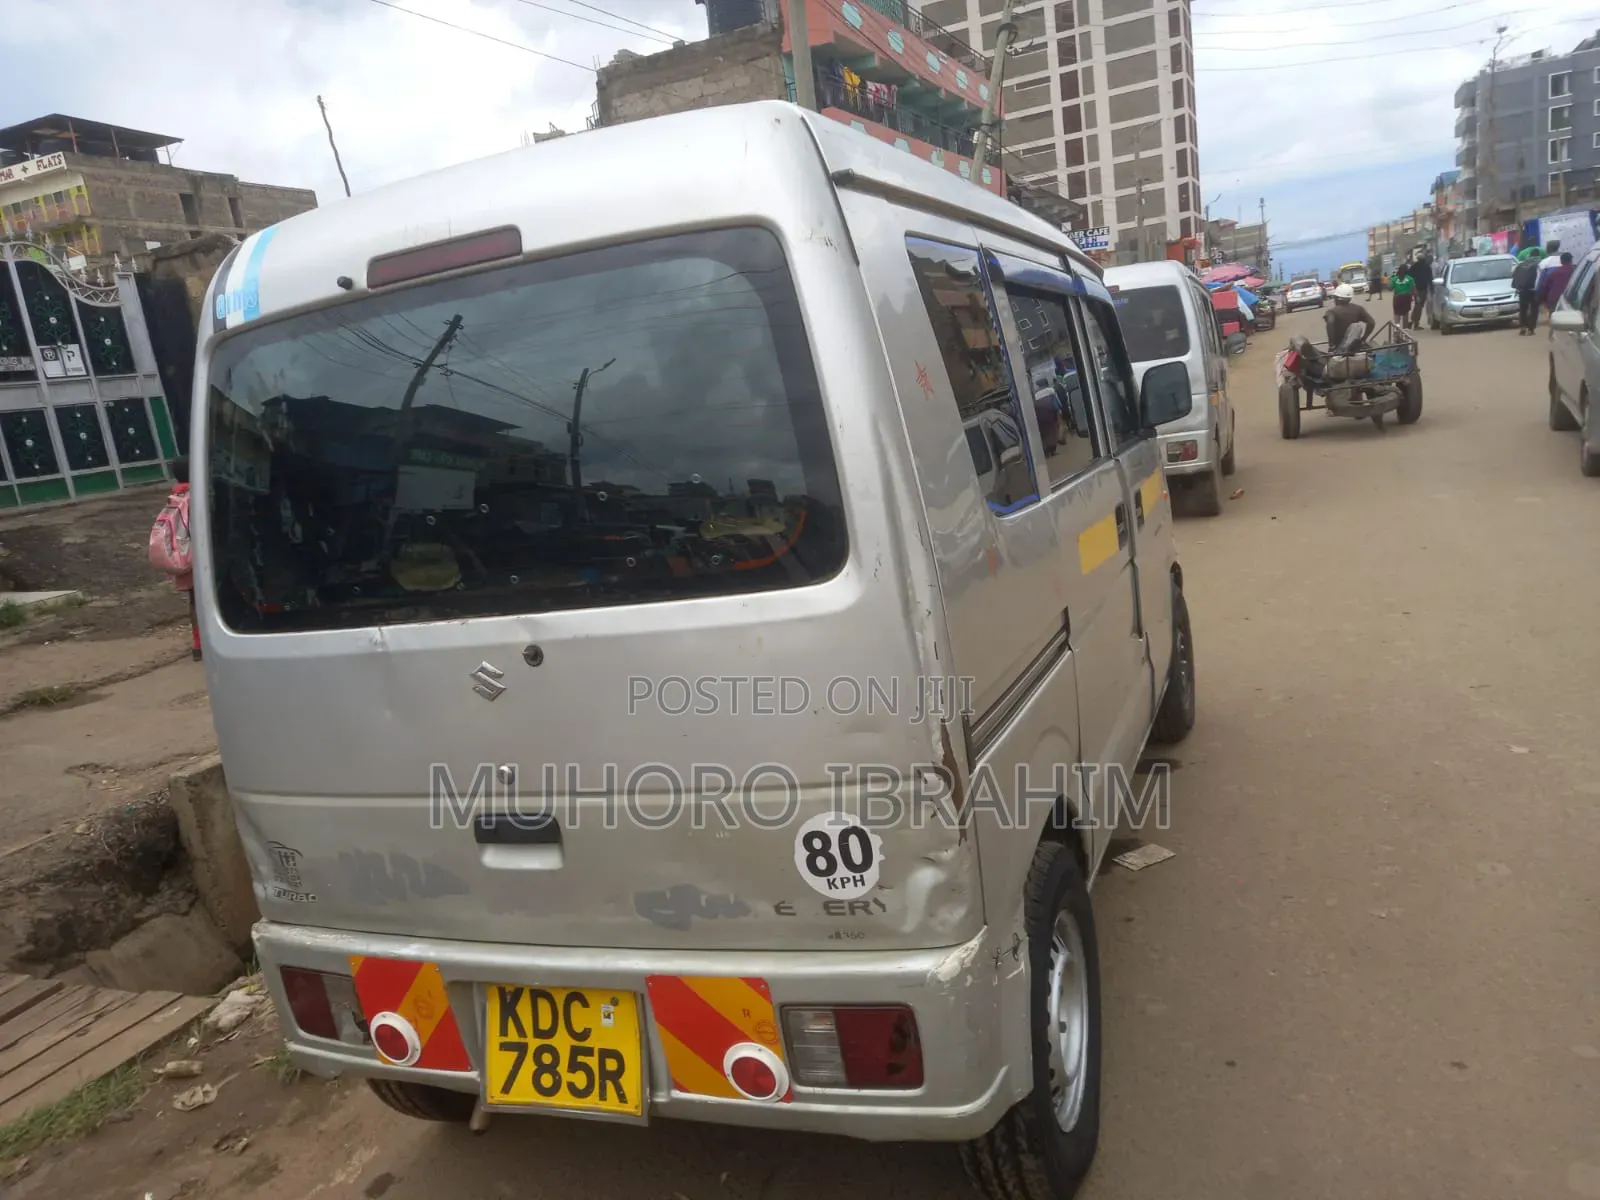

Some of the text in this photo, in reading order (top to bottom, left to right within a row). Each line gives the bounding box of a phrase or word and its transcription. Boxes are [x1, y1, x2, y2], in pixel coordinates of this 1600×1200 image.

[36, 154, 62, 170] FLATS
[1086, 227, 1109, 237] CAFE
[802, 825, 874, 878] 80
[826, 874, 866, 890] KPH
[273, 886, 317, 903] TURBO
[496, 986, 593, 1042] KDC
[498, 1041, 628, 1104] 785R
